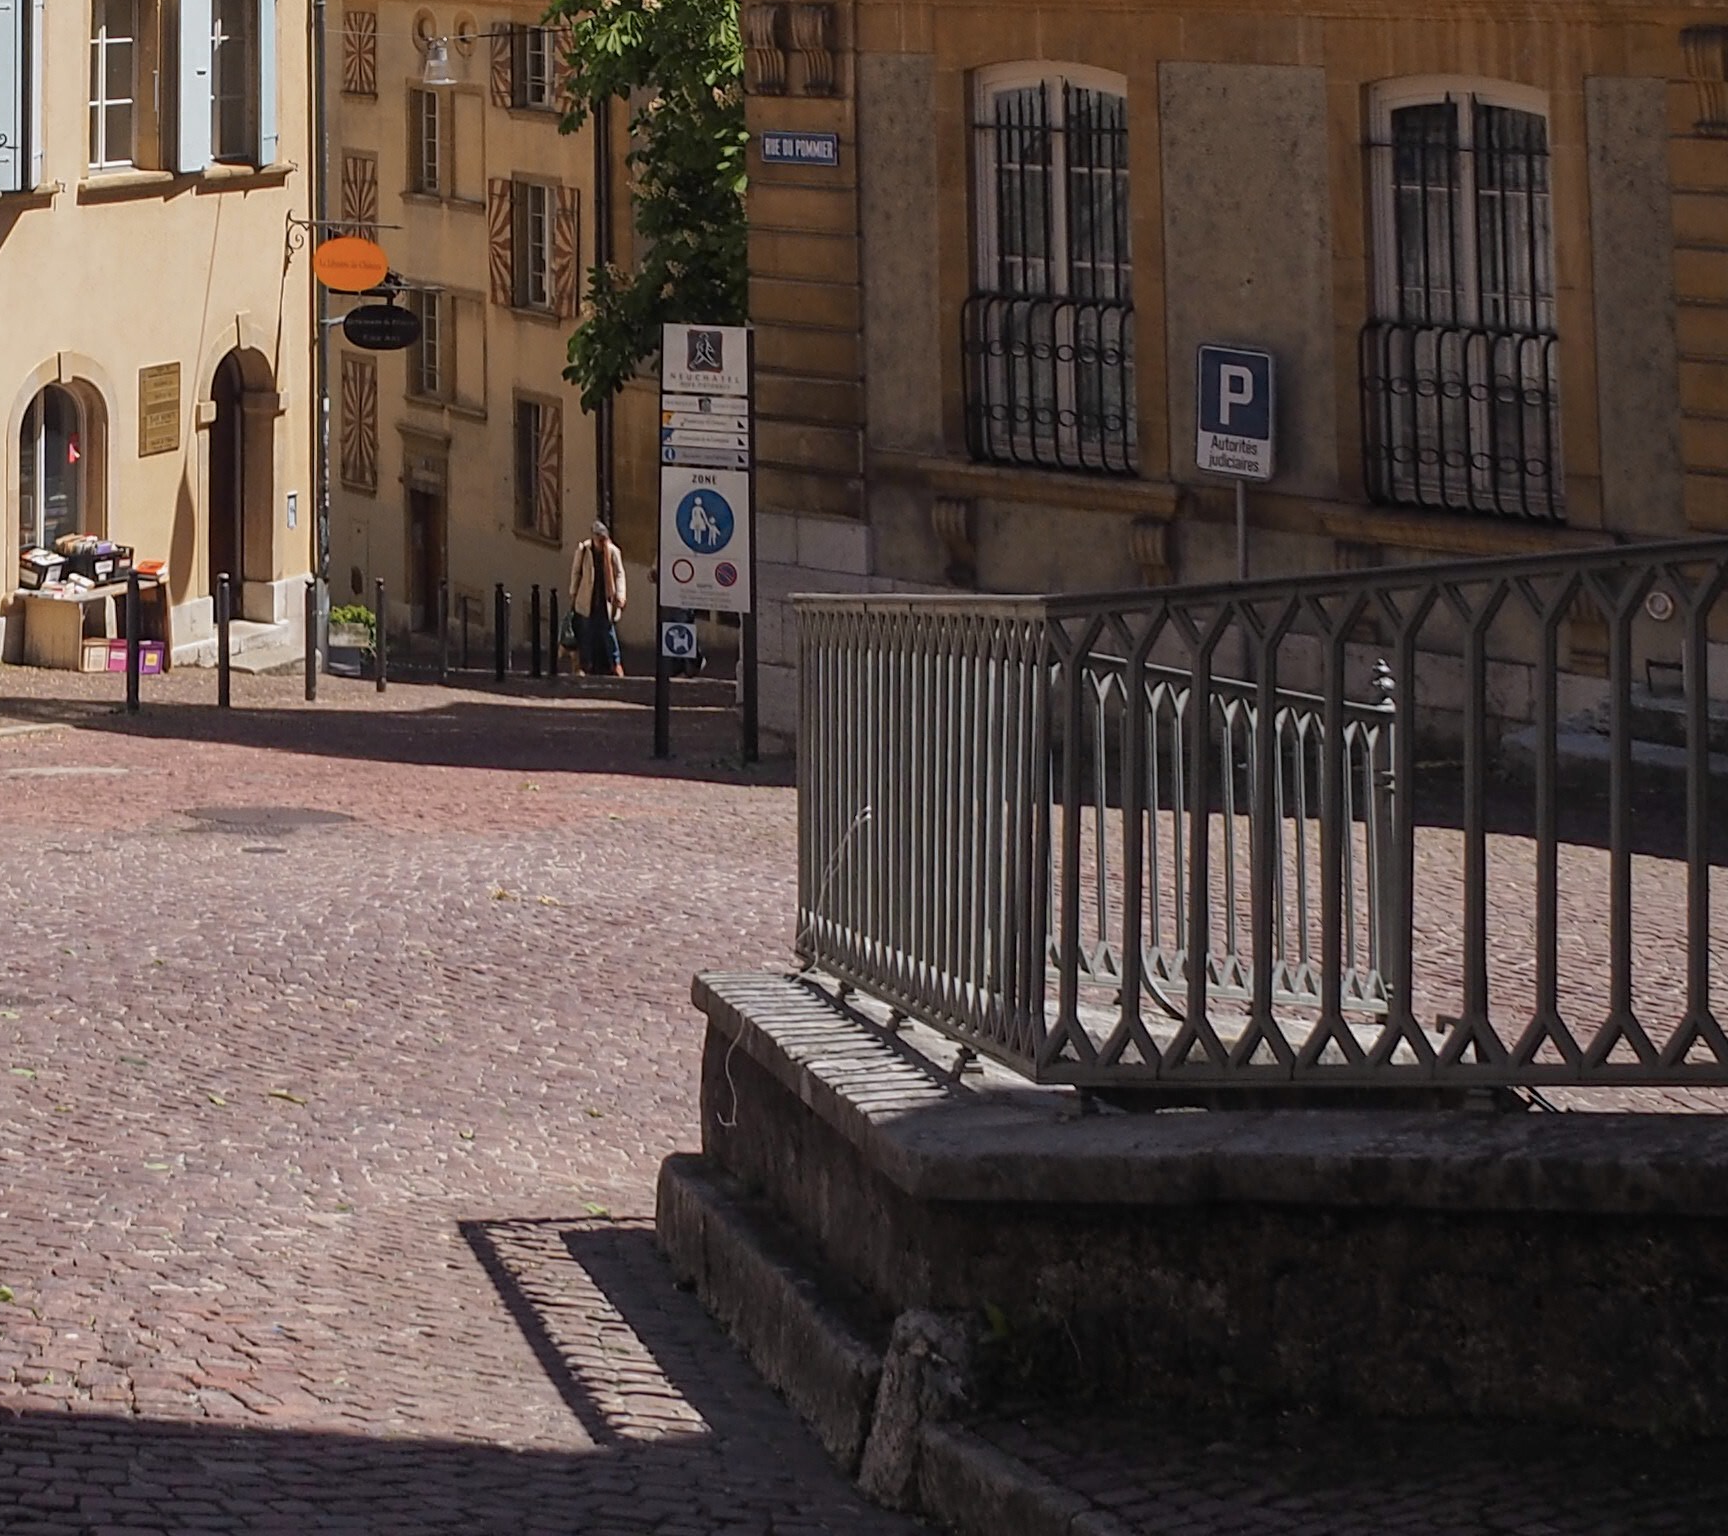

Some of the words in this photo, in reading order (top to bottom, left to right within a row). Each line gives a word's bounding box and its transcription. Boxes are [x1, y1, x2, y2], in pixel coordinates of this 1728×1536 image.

[765, 137, 780, 156] RUE
[782, 138, 793, 157] DU
[795, 139, 833, 159] POMMIER
[1219, 363, 1253, 425] P
[1211, 434, 1258, 455] Autorités
[1208, 450, 1259, 472] judiciaires
[692, 474, 717, 485] ZONE
